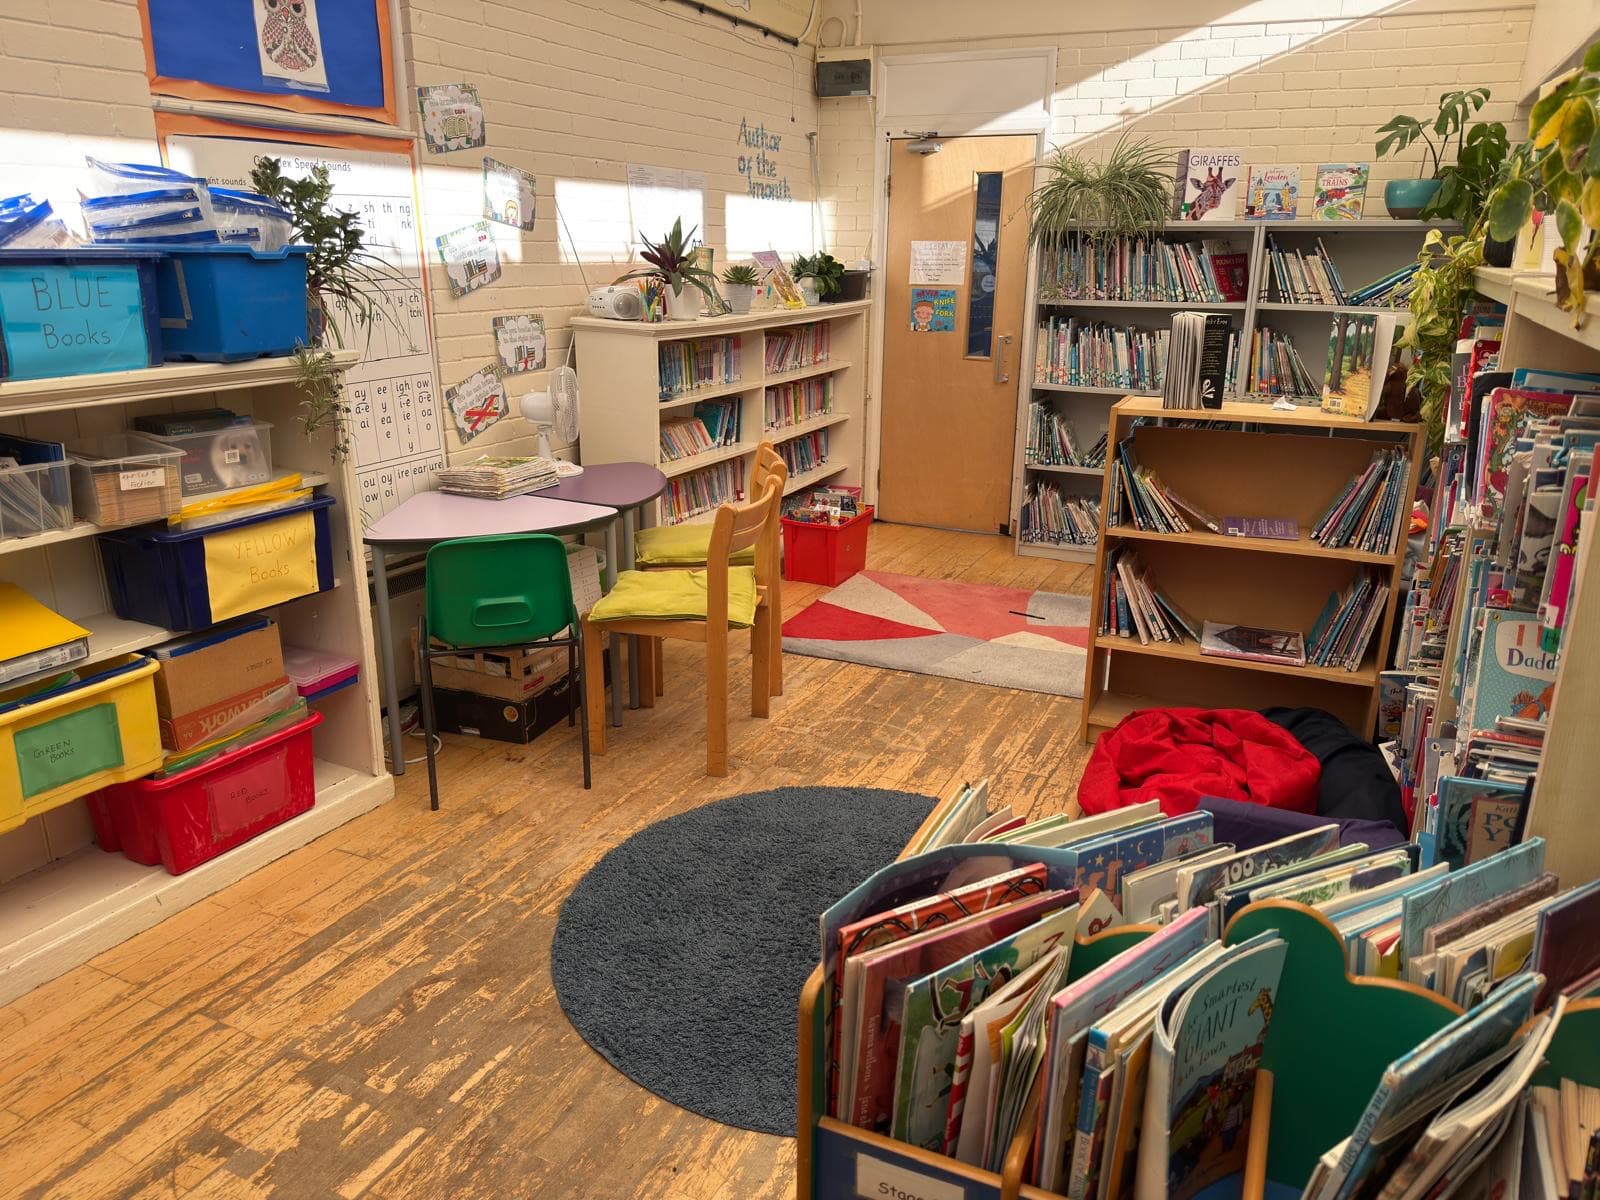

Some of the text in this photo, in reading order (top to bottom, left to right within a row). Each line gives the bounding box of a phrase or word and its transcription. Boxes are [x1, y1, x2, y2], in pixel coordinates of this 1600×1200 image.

[737, 116, 781, 152] Author
[295, 157, 319, 170] Speed
[322, 160, 352, 172] Sounds
[738, 150, 777, 182] of the
[1190, 155, 1240, 167] GIRAFFES
[221, 176, 247, 186] sounds
[749, 176, 792, 202] month
[1322, 178, 1348, 187] TRAINS
[364, 201, 375, 213] sh
[383, 202, 393, 213] th
[400, 205, 411, 216] ng
[368, 218, 412, 229] ti nk
[32, 275, 113, 311] BLUE
[398, 296, 403, 307] y
[409, 292, 419, 303] ch
[934, 297, 957, 306] KNIFE
[935, 309, 954, 317] FORK
[42, 320, 112, 349] Books
[354, 379, 430, 401] ay ee igh ow
[355, 393, 432, 415] a-e y i-e o-e
[360, 408, 432, 429] ai ea ie oa
[385, 430, 391, 439] e
[425, 423, 431, 431] o
[408, 441, 414, 452] y
[363, 461, 442, 488] ou oy ire ear ure
[365, 487, 394, 503] ow oi
[250, 559, 291, 584] Books
[1506, 648, 1560, 671] Dadd
[33, 739, 71, 759] GREEN
[230, 787, 248, 800] RED
[1220, 856, 1254, 888] 100
[1202, 977, 1257, 1015] Smartest
[1184, 995, 1243, 1065] GIANT
[1354, 1107, 1378, 1144] GREEN
[878, 1181, 940, 1200] Sta
